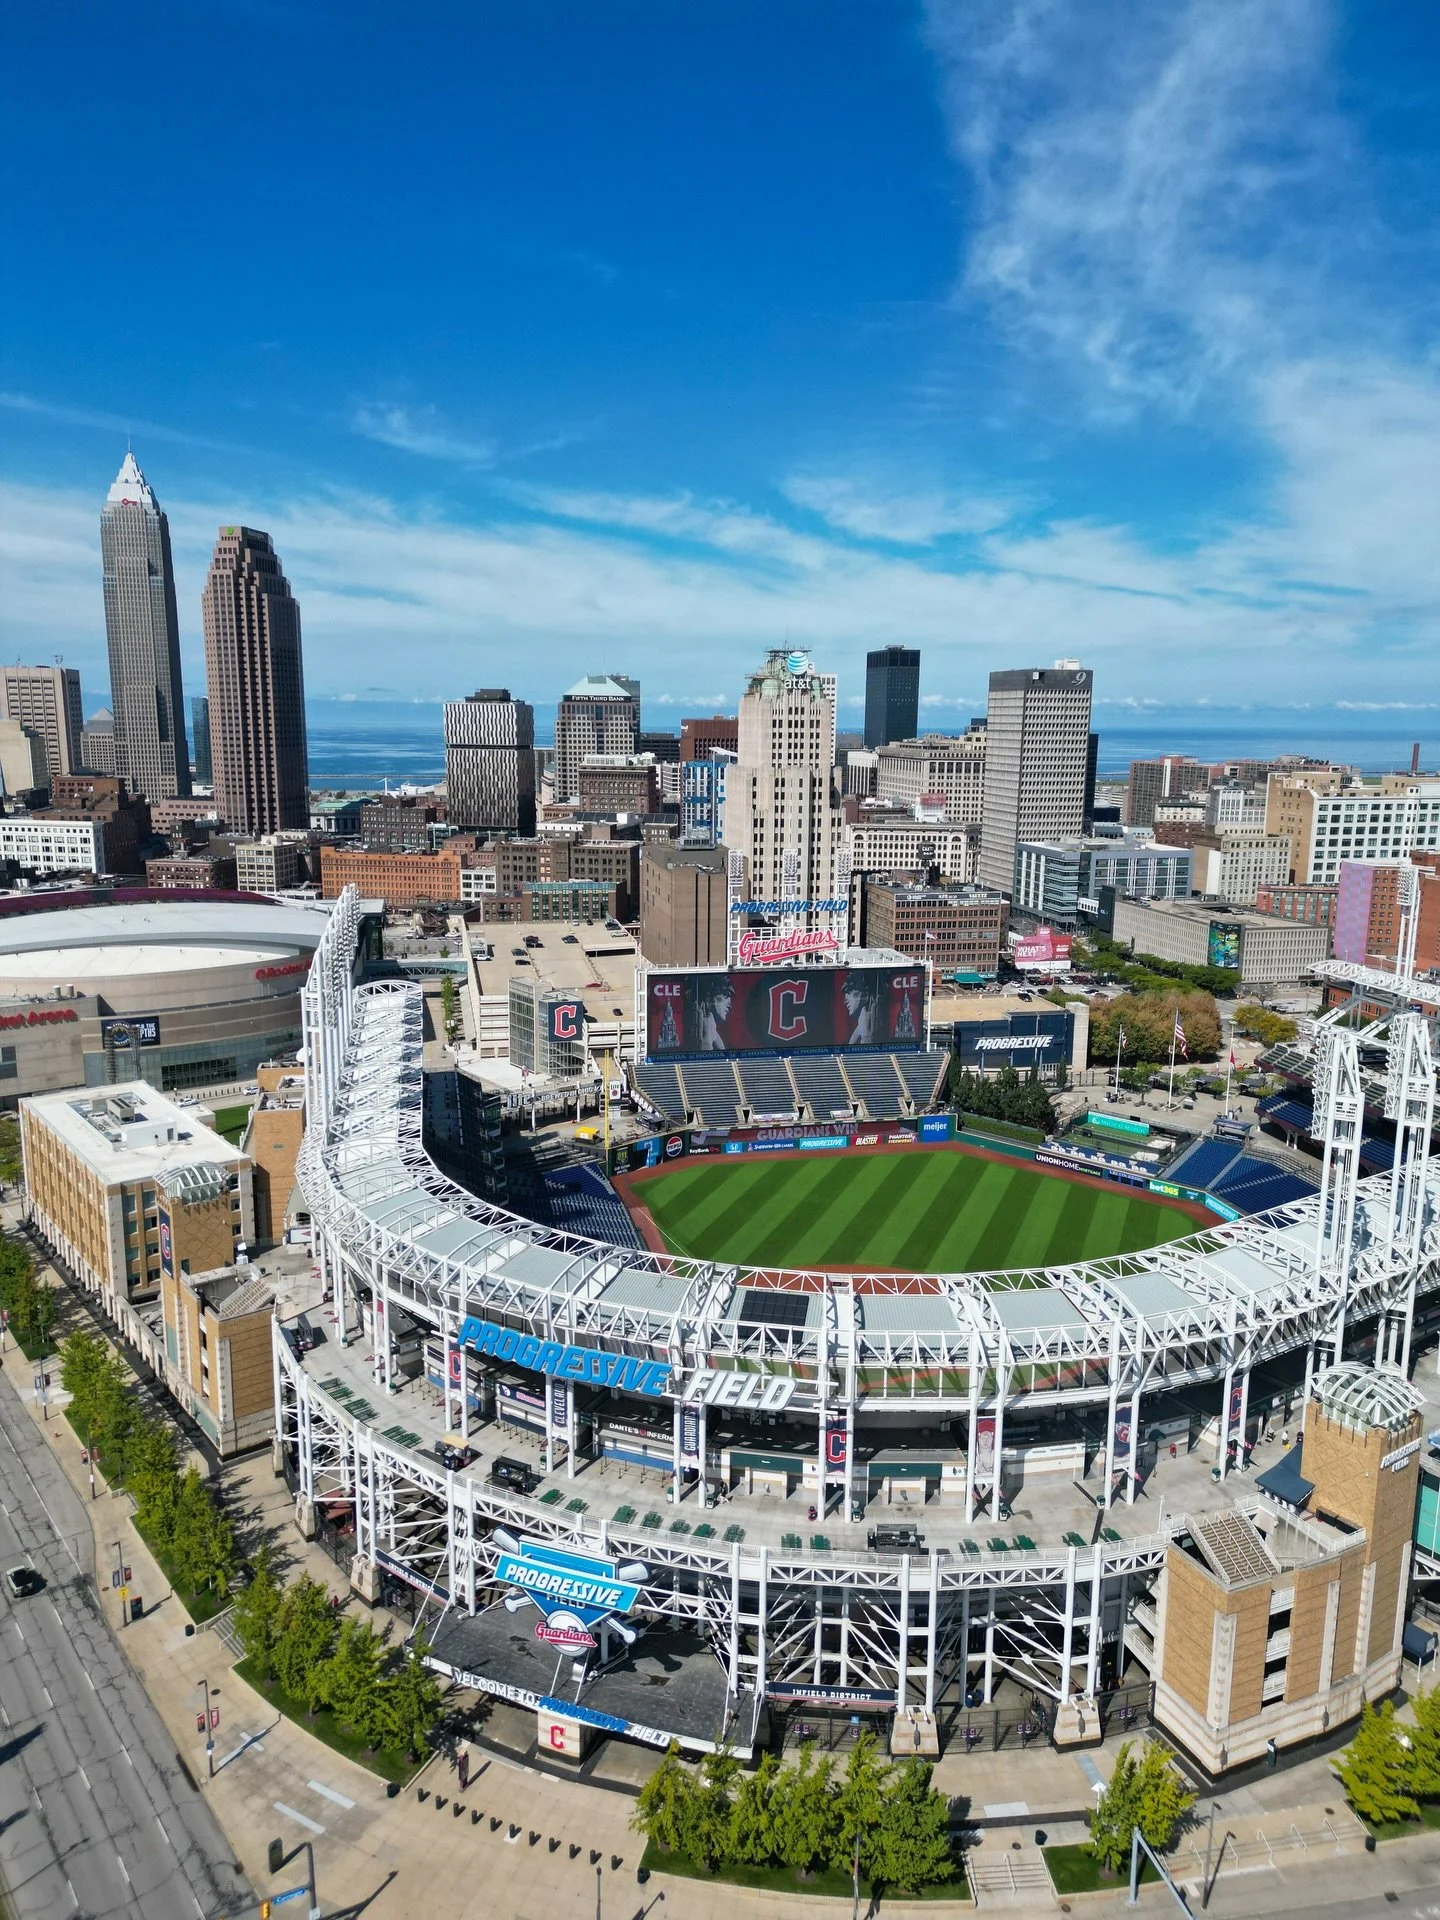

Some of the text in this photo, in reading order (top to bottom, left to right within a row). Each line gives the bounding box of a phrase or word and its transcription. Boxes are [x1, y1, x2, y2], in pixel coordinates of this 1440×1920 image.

[784, 676, 811, 689] at&t
[1072, 672, 1086, 686] 9
[730, 900, 848, 913] PROGRESSIVE FIELD
[739, 928, 839, 966] Guardians
[654, 984, 680, 996] CLE
[892, 976, 918, 989] CLE
[27, 1009, 77, 1026] Arena
[554, 1005, 576, 1038] C
[768, 979, 808, 1041] C
[975, 1036, 1054, 1050] PROGRESSIVE
[757, 1123, 858, 1140] GUARDIANS WIN
[924, 1122, 947, 1131] meijer
[856, 1137, 878, 1145] BLASTER
[1150, 1182, 1178, 1196] bet365
[161, 1223, 170, 1259] C
[448, 1350, 462, 1380] C
[456, 1316, 798, 1410] PROGRESSIVE FIELD
[554, 1382, 566, 1424] CLEVELAND
[1230, 1388, 1243, 1421] C
[610, 1422, 639, 1434] DANTE'S
[684, 1409, 696, 1451] GUARDIANS
[826, 1430, 846, 1464] C
[504, 1564, 622, 1606] PROGRESSIVE
[546, 1593, 585, 1609] FIELD
[535, 1620, 598, 1648] Guardians
[452, 1667, 670, 1747] WELCOME TO PROGRESSIVE FIELD
[550, 1725, 565, 1750] C
